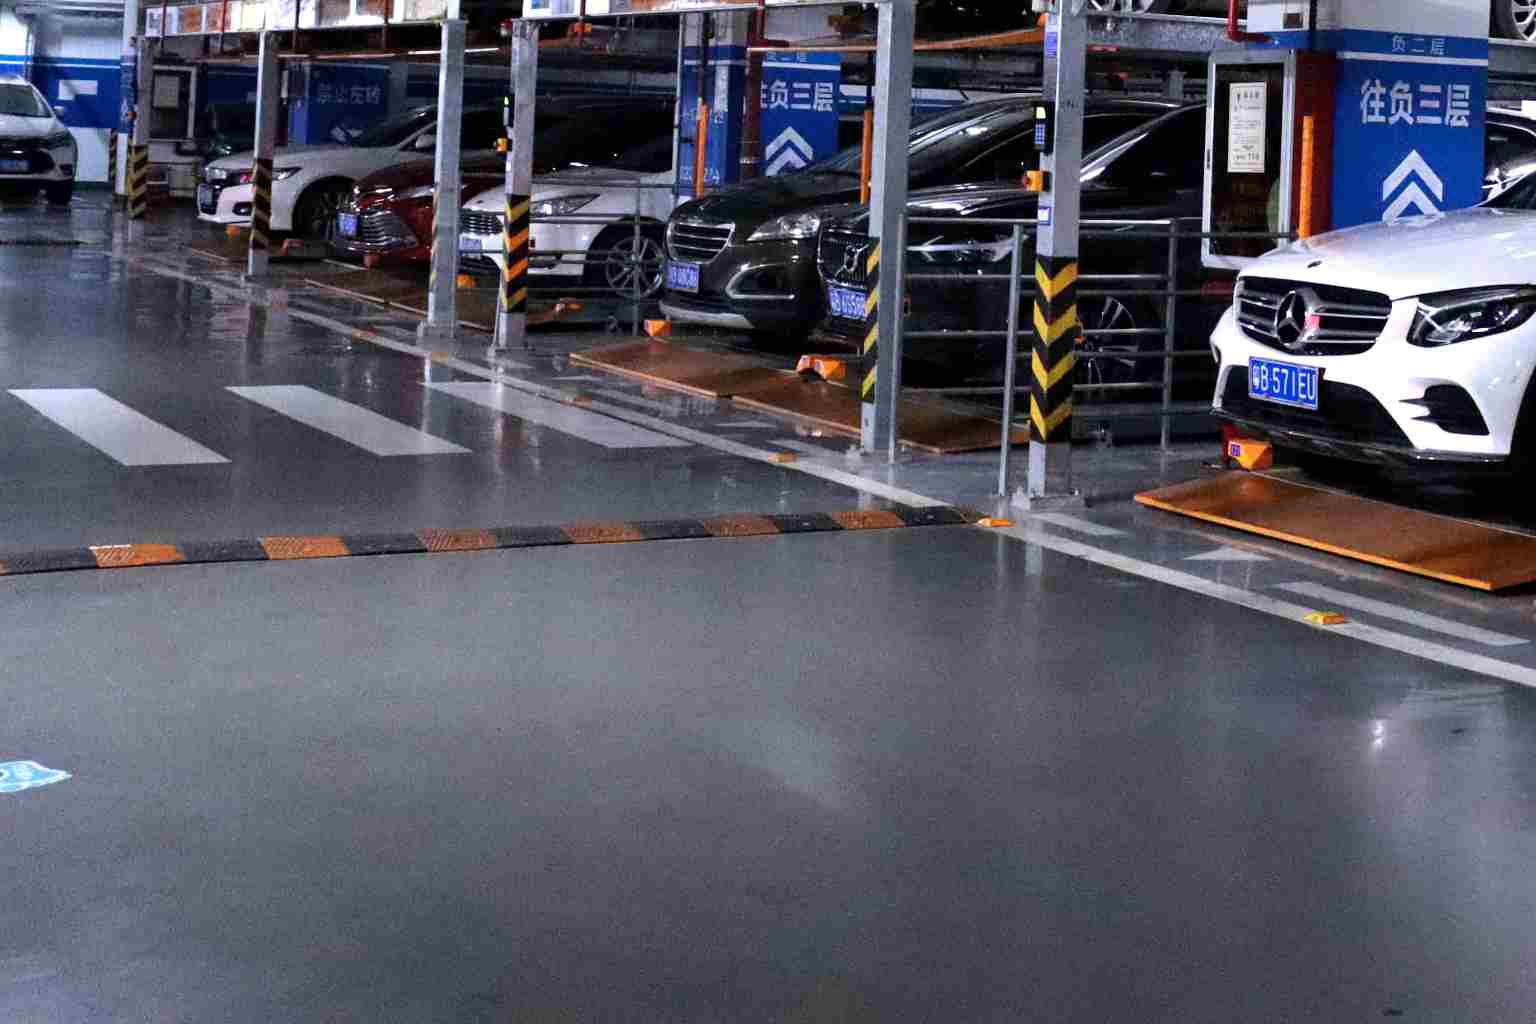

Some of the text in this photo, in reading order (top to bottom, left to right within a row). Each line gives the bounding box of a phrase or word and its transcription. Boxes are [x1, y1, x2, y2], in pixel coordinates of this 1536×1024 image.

[1391, 34, 1446, 56] 负二层
[1360, 79, 1471, 128] 往负三层
